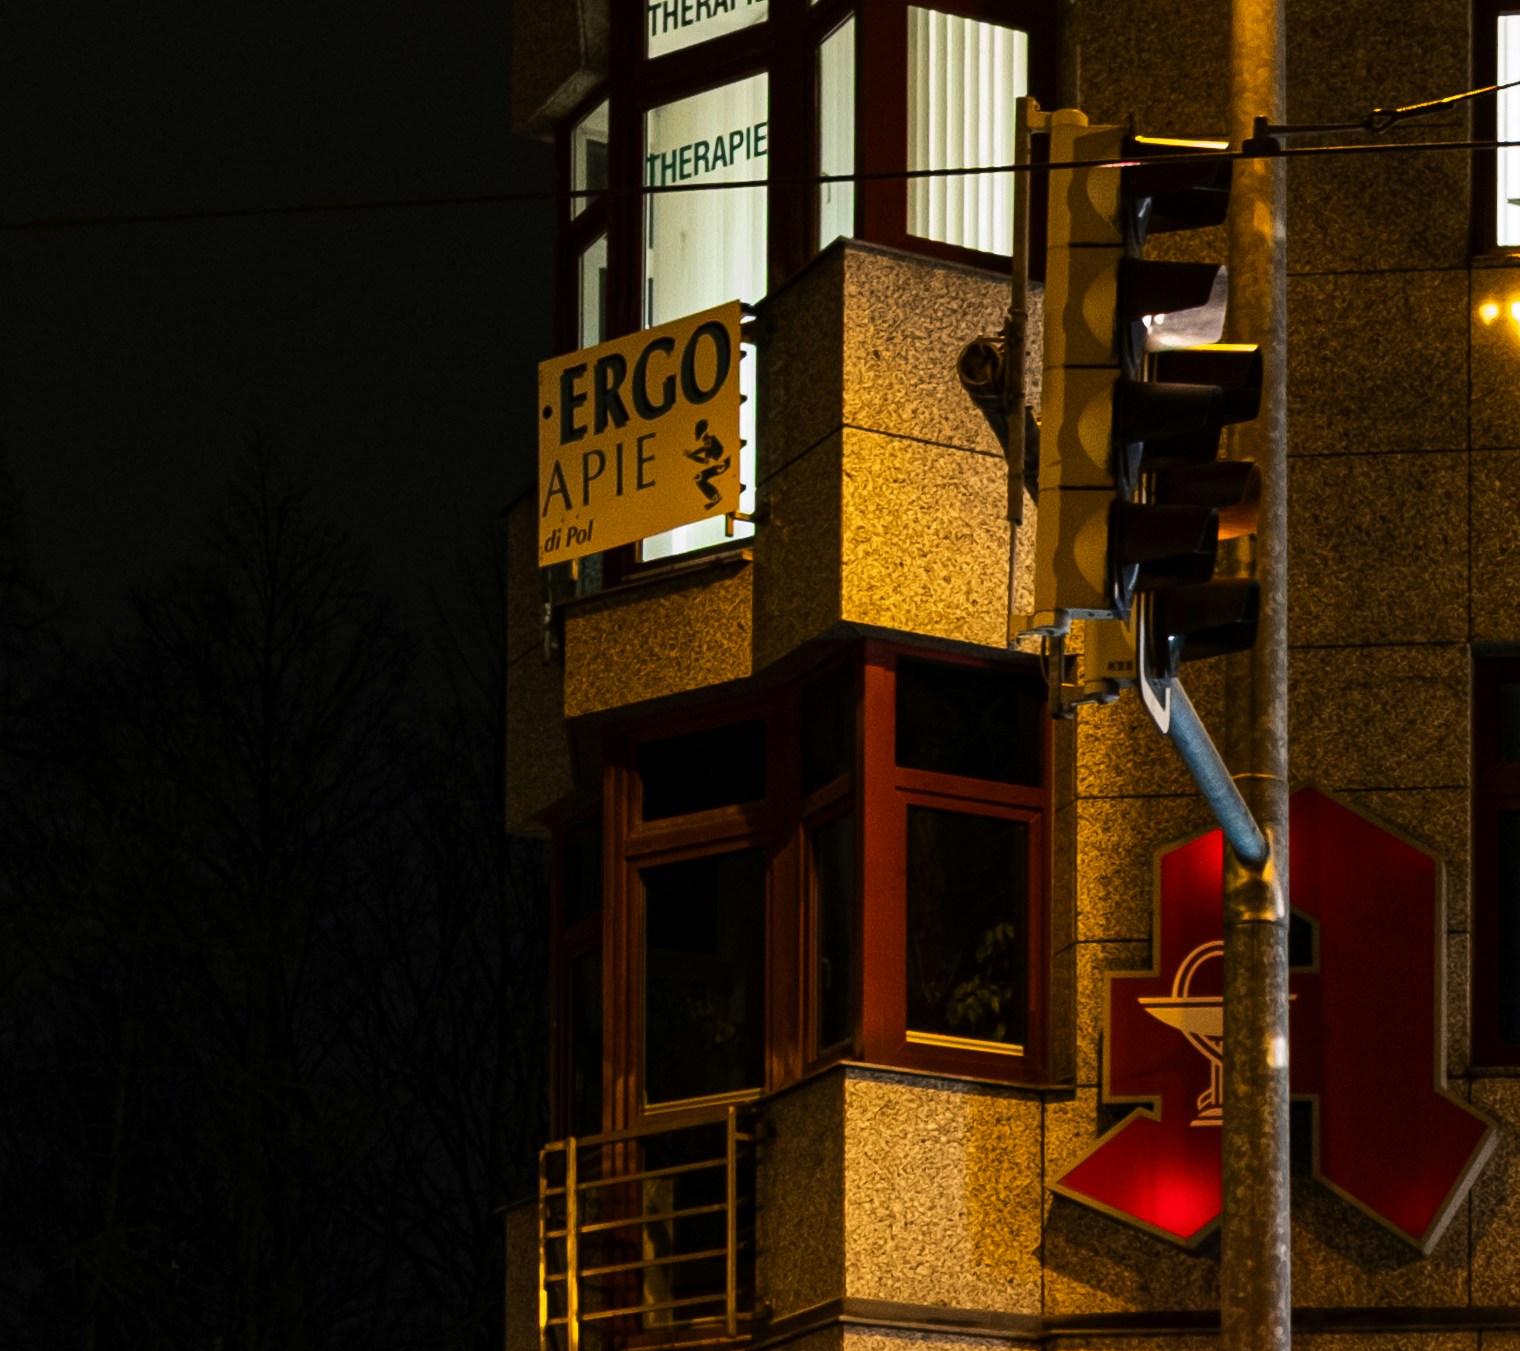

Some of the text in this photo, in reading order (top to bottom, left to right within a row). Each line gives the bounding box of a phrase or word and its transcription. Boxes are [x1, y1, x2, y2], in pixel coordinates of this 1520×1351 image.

[648, 0, 764, 37] THERA
[646, 121, 768, 186] THERAPIE
[560, 320, 732, 446] ERGO
